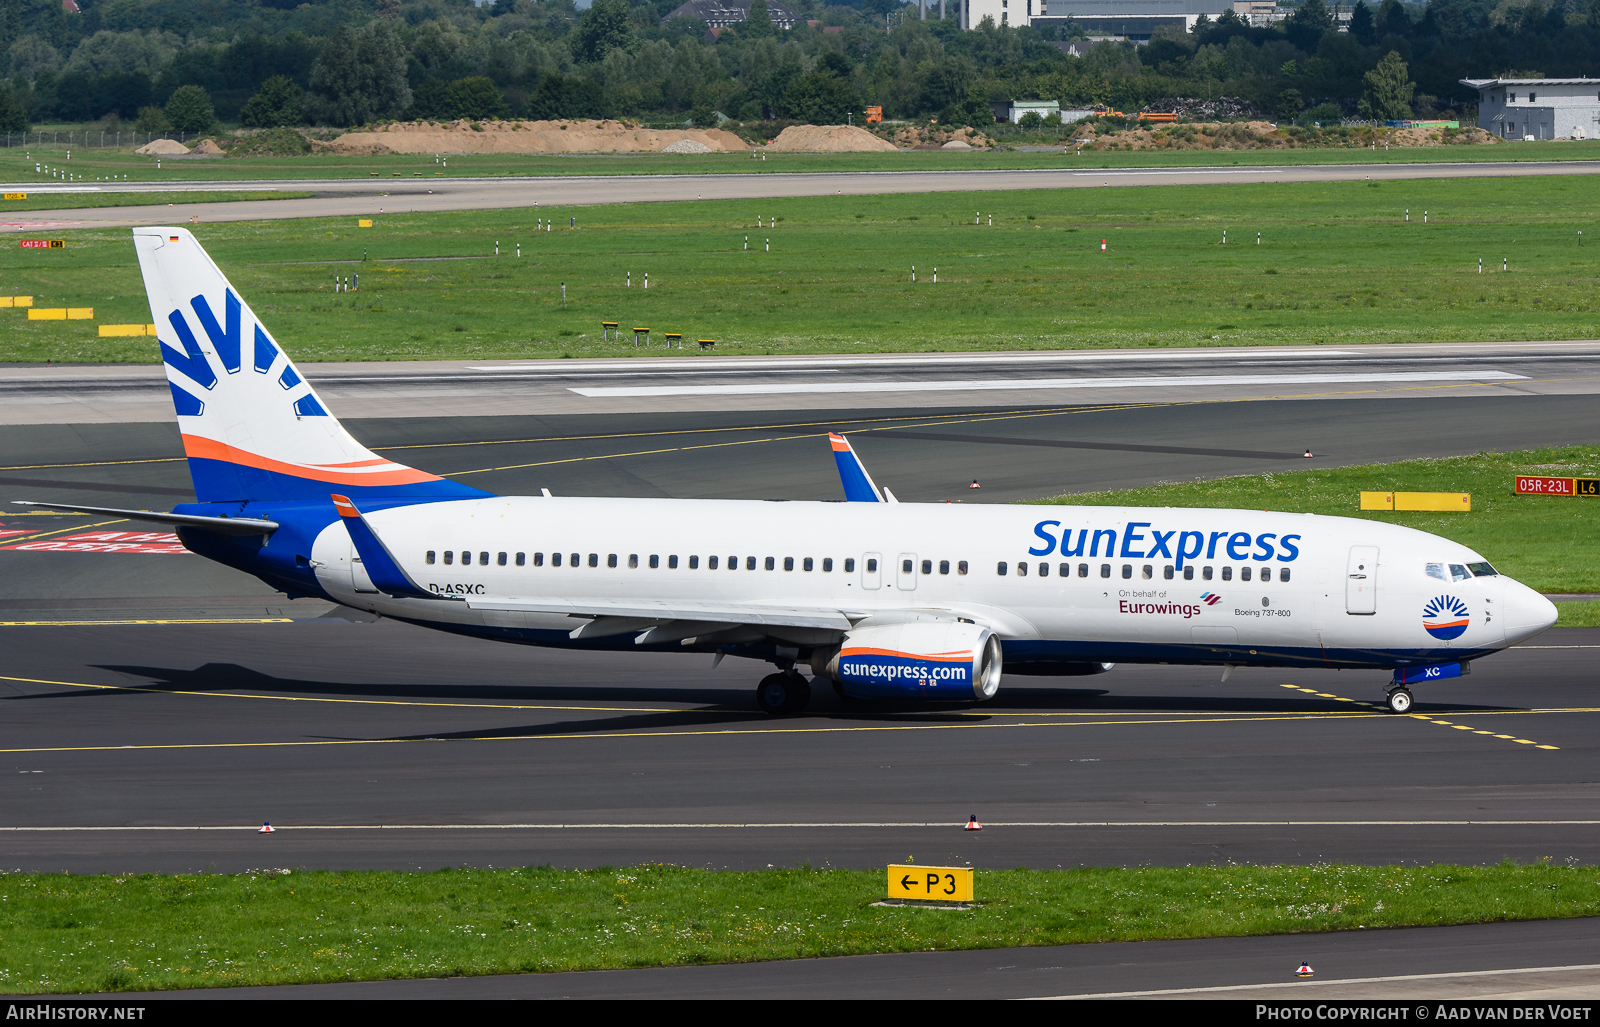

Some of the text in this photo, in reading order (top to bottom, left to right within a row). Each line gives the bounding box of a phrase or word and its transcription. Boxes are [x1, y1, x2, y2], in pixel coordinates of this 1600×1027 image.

[1520, 479, 1569, 493] 05R-23L
[1581, 482, 1596, 494] L6
[1028, 519, 1302, 572] SunExpress
[429, 583, 485, 594] D-ASXC
[1118, 589, 1167, 599] On behalf of
[1119, 600, 1201, 618] Eurowings
[1234, 608, 1292, 618] Boeing 737-800
[843, 663, 967, 682] sunexpress.com
[1425, 667, 1441, 678] XC
[926, 873, 956, 895] P3
